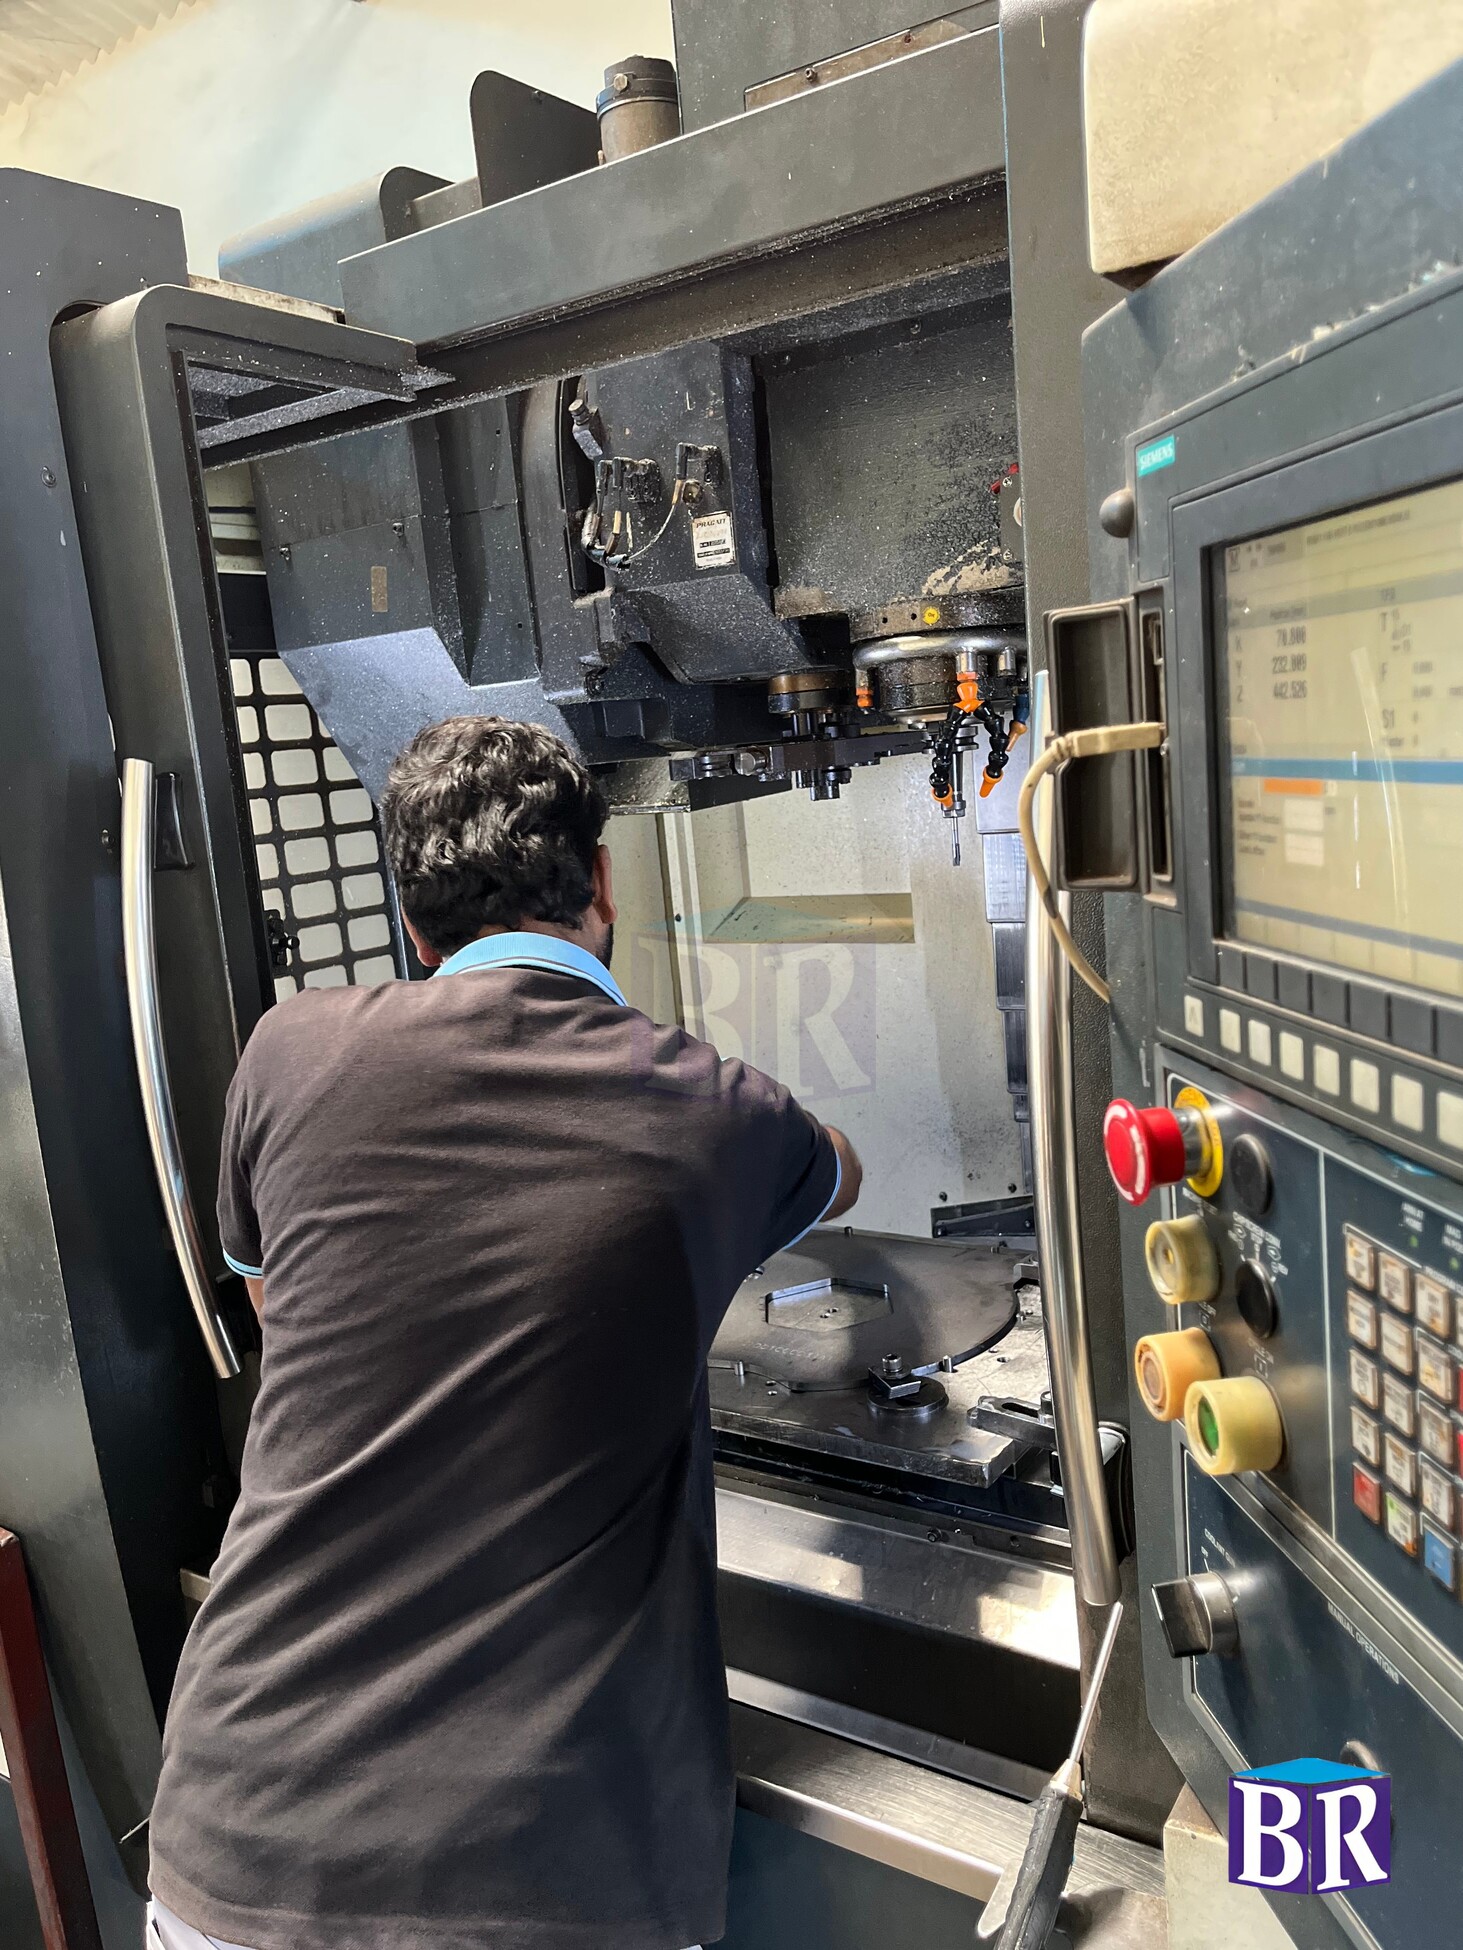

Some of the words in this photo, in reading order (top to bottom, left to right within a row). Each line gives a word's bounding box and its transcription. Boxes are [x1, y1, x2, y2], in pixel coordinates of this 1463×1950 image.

[1140, 441, 1174, 471] SIEMENS
[1327, 1601, 1355, 1639] MANUAL
[1355, 1631, 1400, 1685] OPERATIONS
